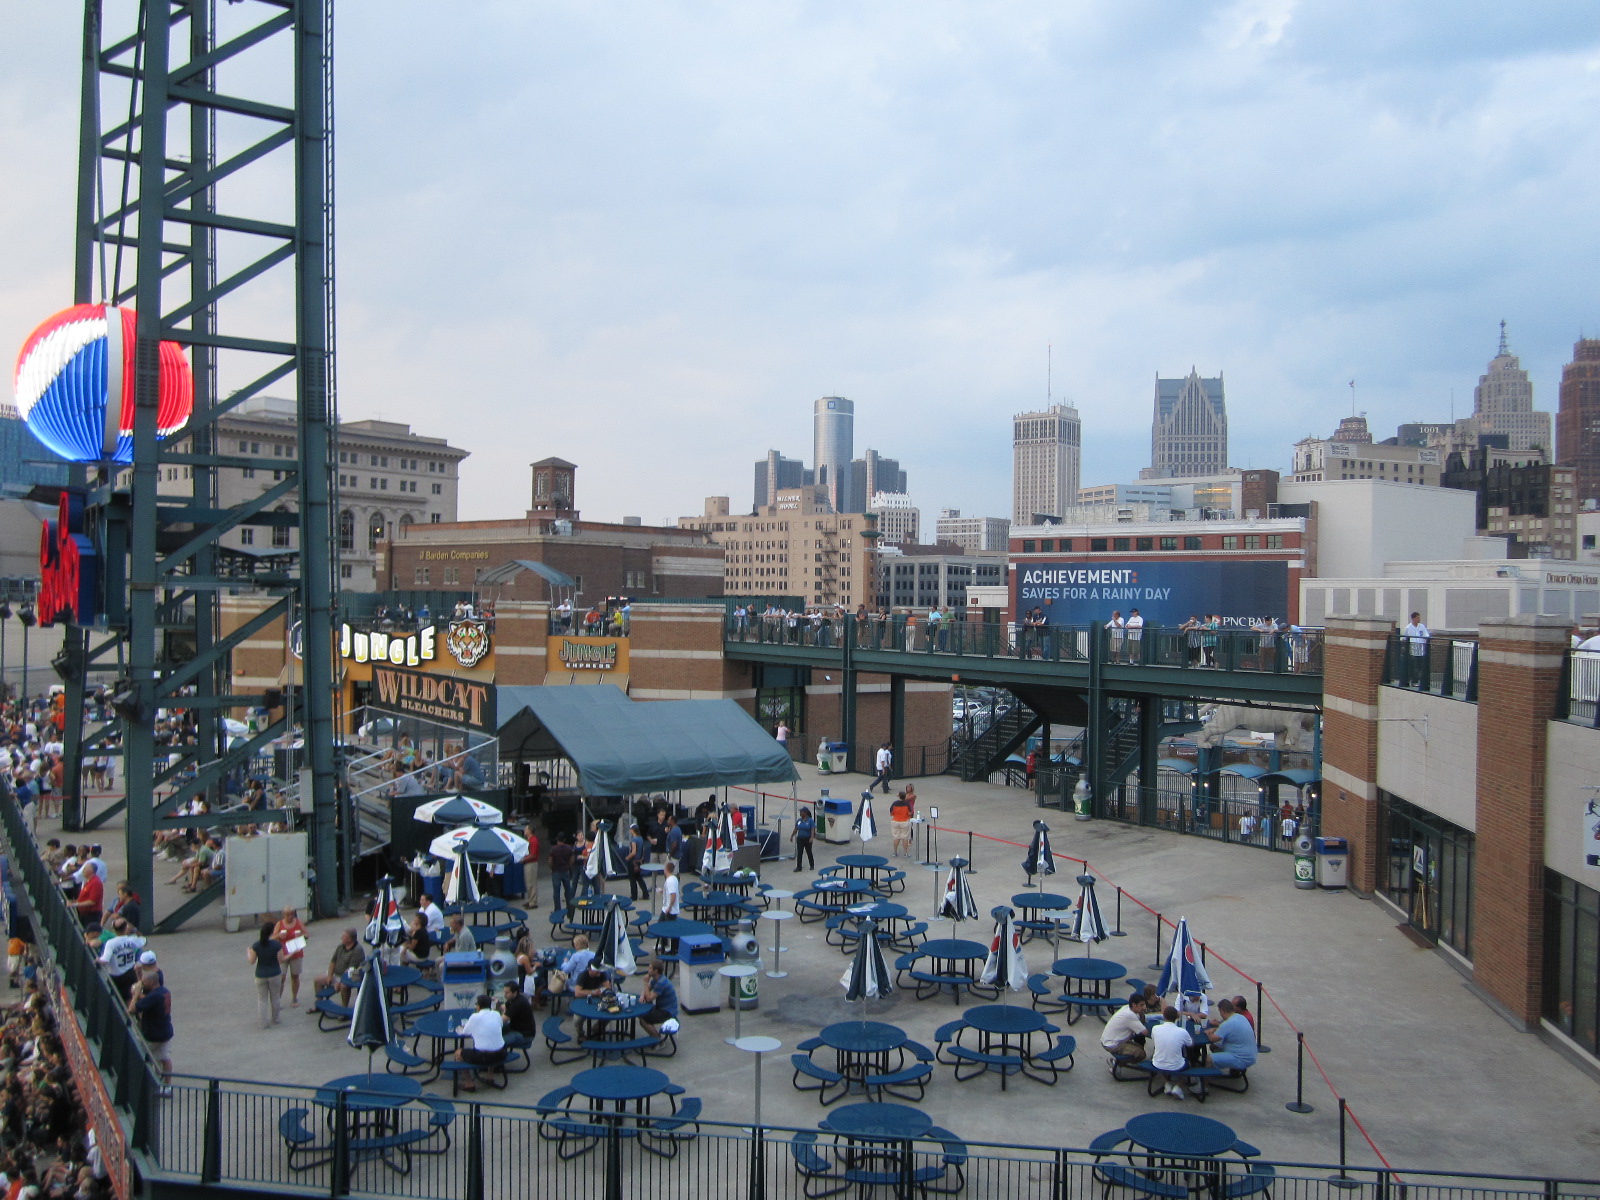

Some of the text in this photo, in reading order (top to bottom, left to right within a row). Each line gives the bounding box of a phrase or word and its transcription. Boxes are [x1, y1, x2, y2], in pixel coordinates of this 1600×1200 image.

[425, 550, 489, 562] Barden Companies
[1023, 570, 1137, 584] ACHIEVEMENT:
[1022, 588, 1171, 600] SAVES FOR A RAINY DAY
[1223, 617, 1279, 627] PNC BAK
[341, 623, 435, 666] JUNGLE
[560, 640, 616, 663] JUNGLE
[376, 669, 487, 727] WILDCAT
[401, 699, 464, 722] BLEACHERS
[118, 952, 135, 967] 35
